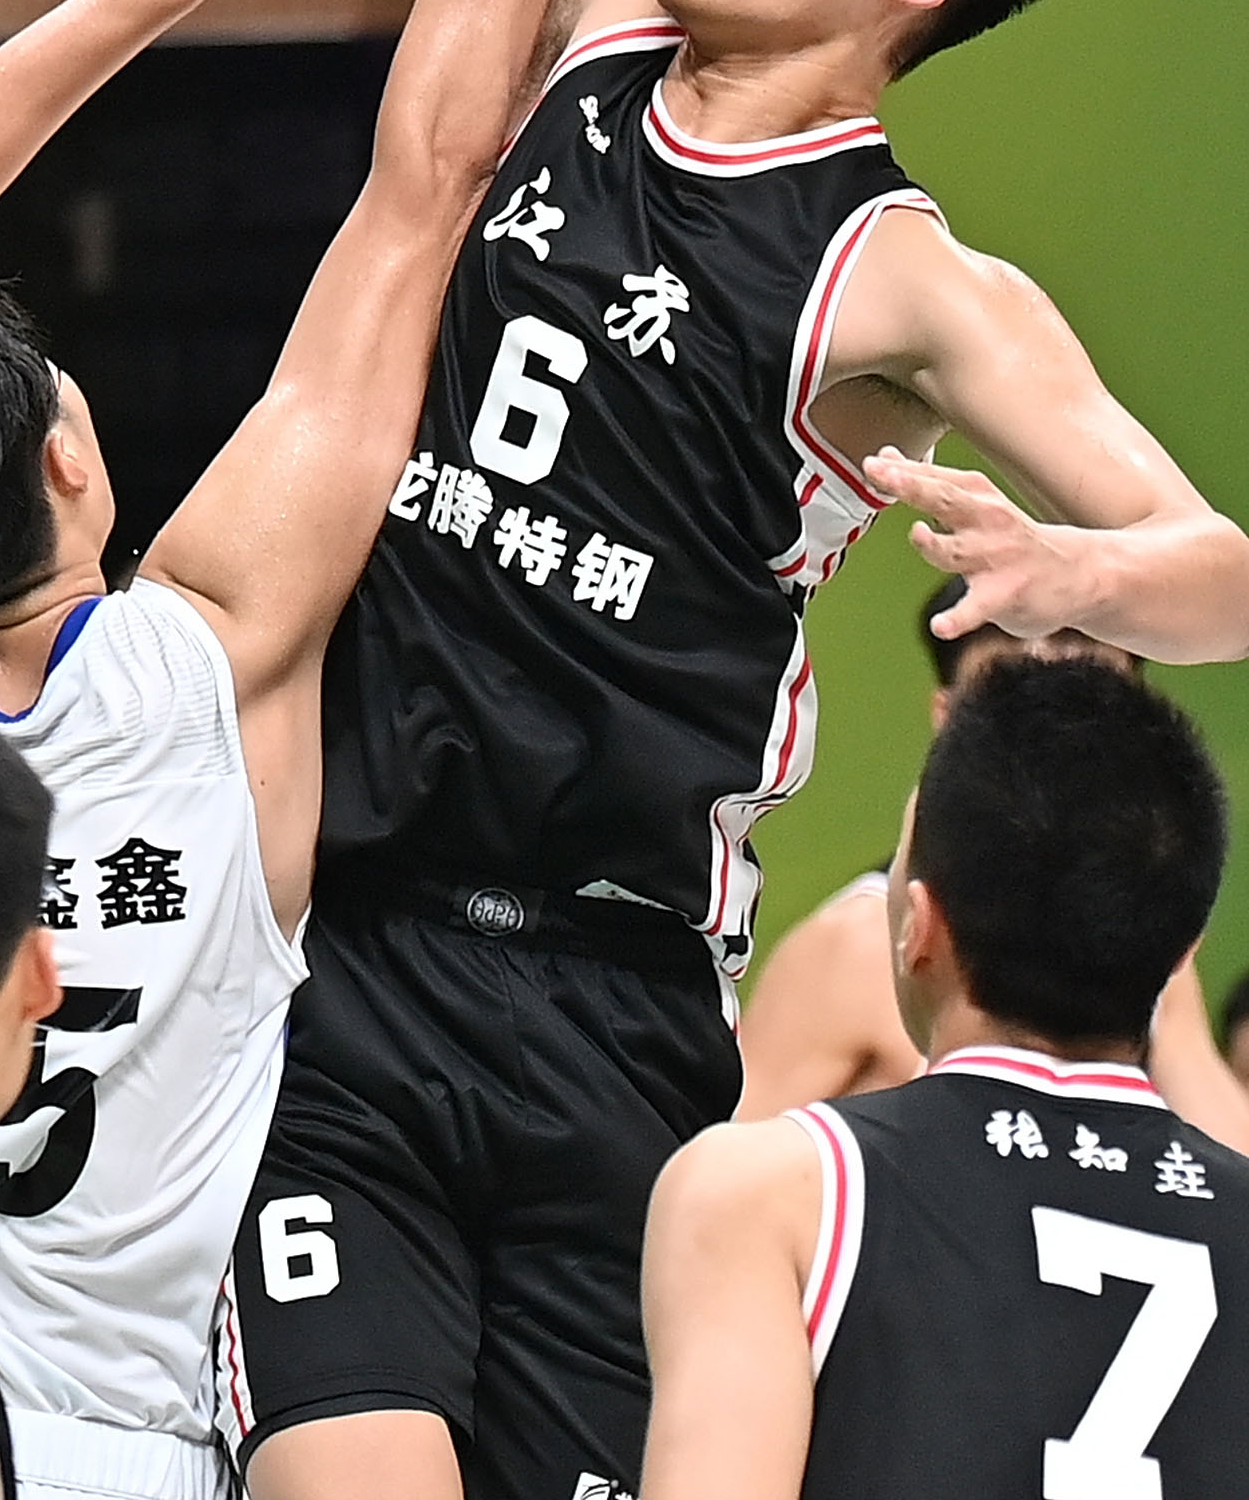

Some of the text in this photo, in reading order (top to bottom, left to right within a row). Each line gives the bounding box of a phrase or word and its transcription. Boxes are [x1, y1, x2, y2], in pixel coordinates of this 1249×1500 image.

[469, 315, 588, 485] 6
[258, 1194, 340, 1303] 6
[1031, 1206, 1218, 1500] 7
